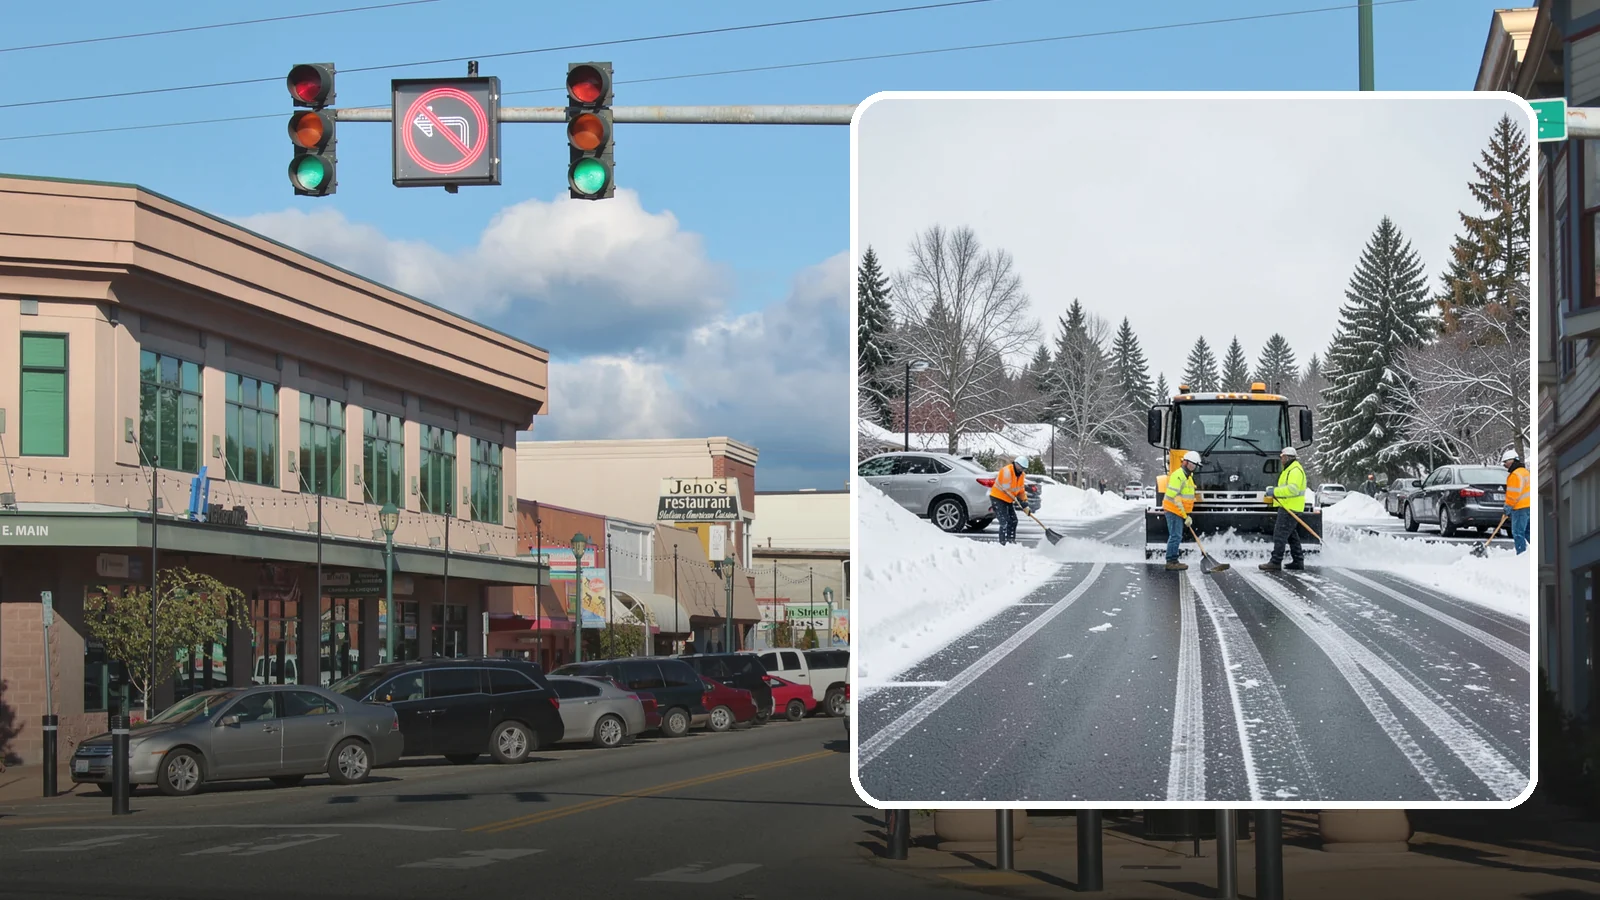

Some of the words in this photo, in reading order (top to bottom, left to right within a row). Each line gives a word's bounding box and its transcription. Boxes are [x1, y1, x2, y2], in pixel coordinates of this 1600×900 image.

[669, 480, 728, 494] Jeno's
[665, 496, 731, 509] restaurant
[686, 510, 714, 519] American
[715, 509, 738, 519] Cuisine
[2, 525, 13, 536] E.
[15, 525, 49, 536] MAIN
[797, 608, 828, 617] Street
[790, 619, 823, 627] lass
